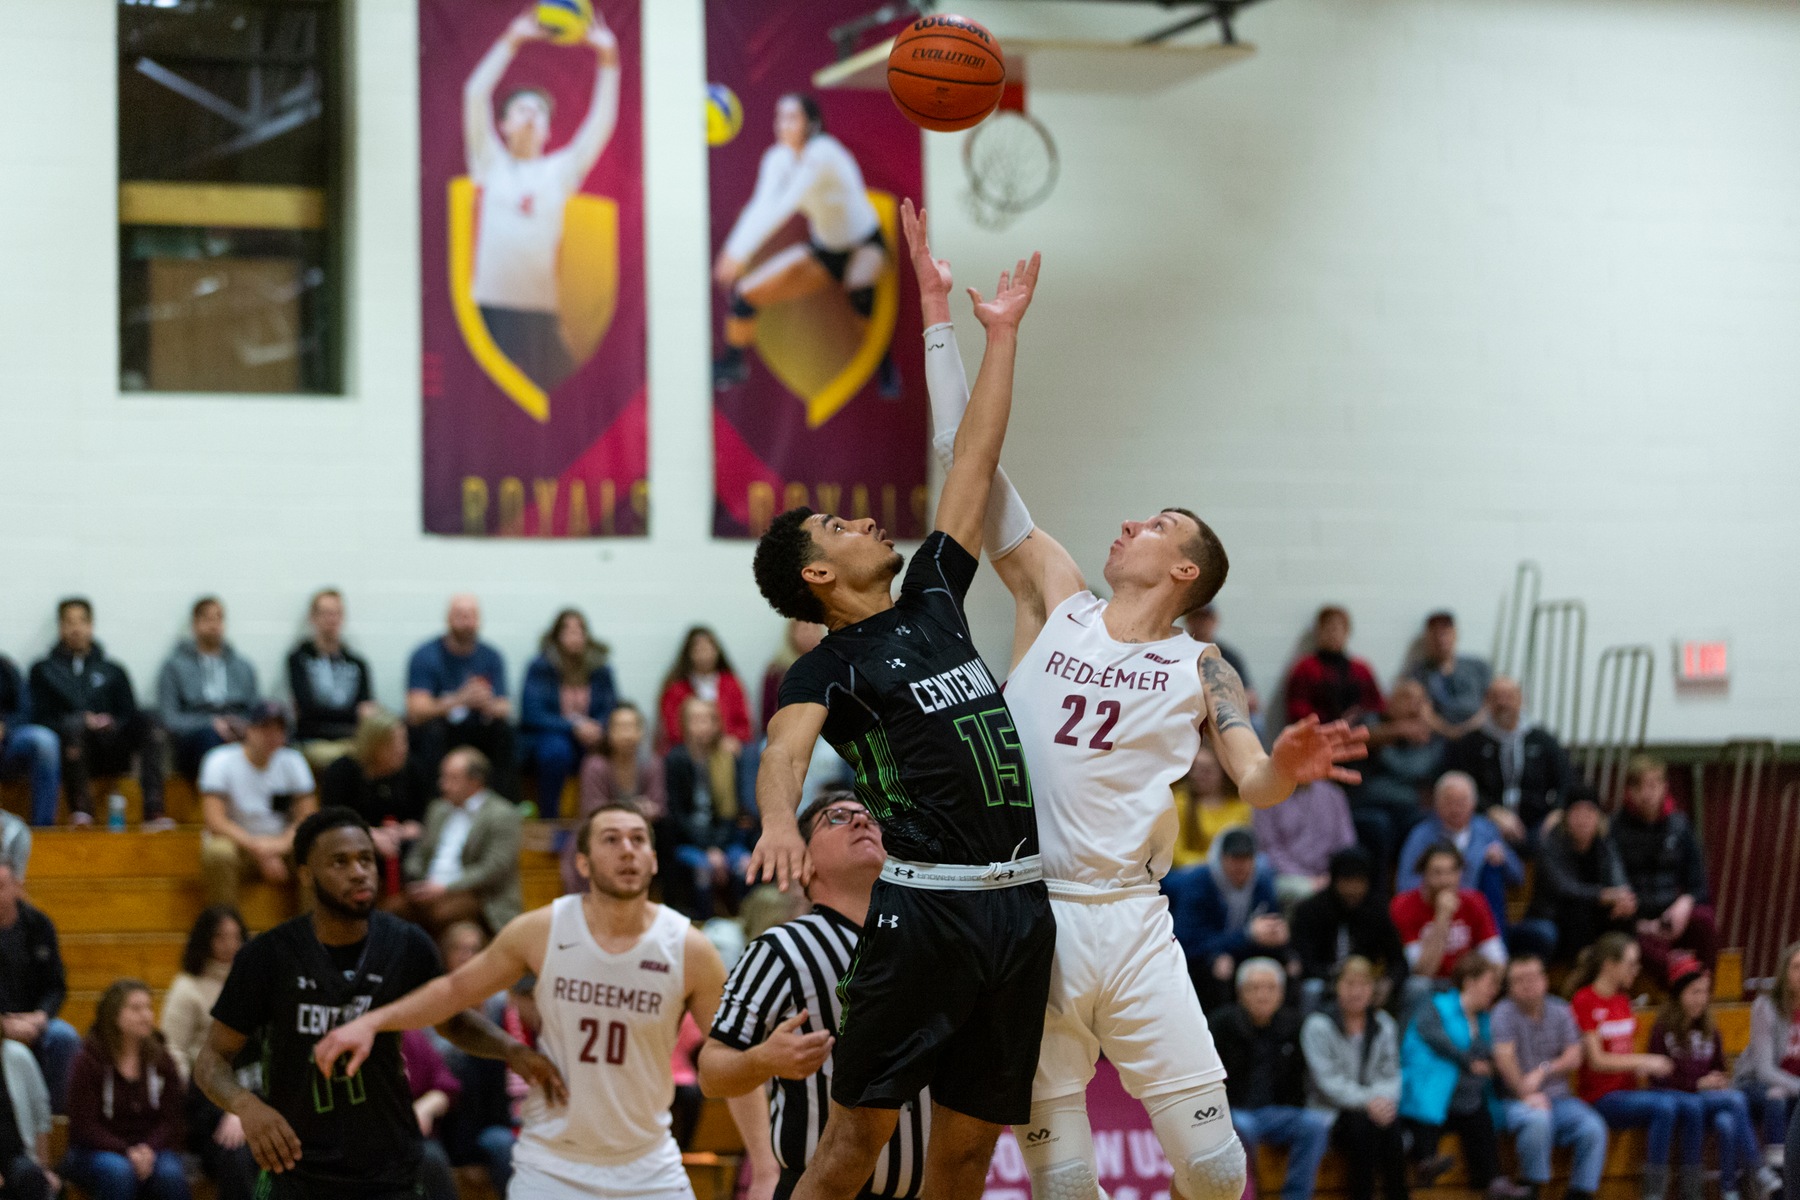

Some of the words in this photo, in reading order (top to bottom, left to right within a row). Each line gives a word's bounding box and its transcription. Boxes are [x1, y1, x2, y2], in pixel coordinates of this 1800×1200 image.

[912, 48, 987, 68] EVOLUTION
[1053, 694, 1121, 751] 22
[953, 706, 1033, 808] 15
[553, 976, 663, 1015] REDEEMER
[578, 1017, 627, 1066] 20
